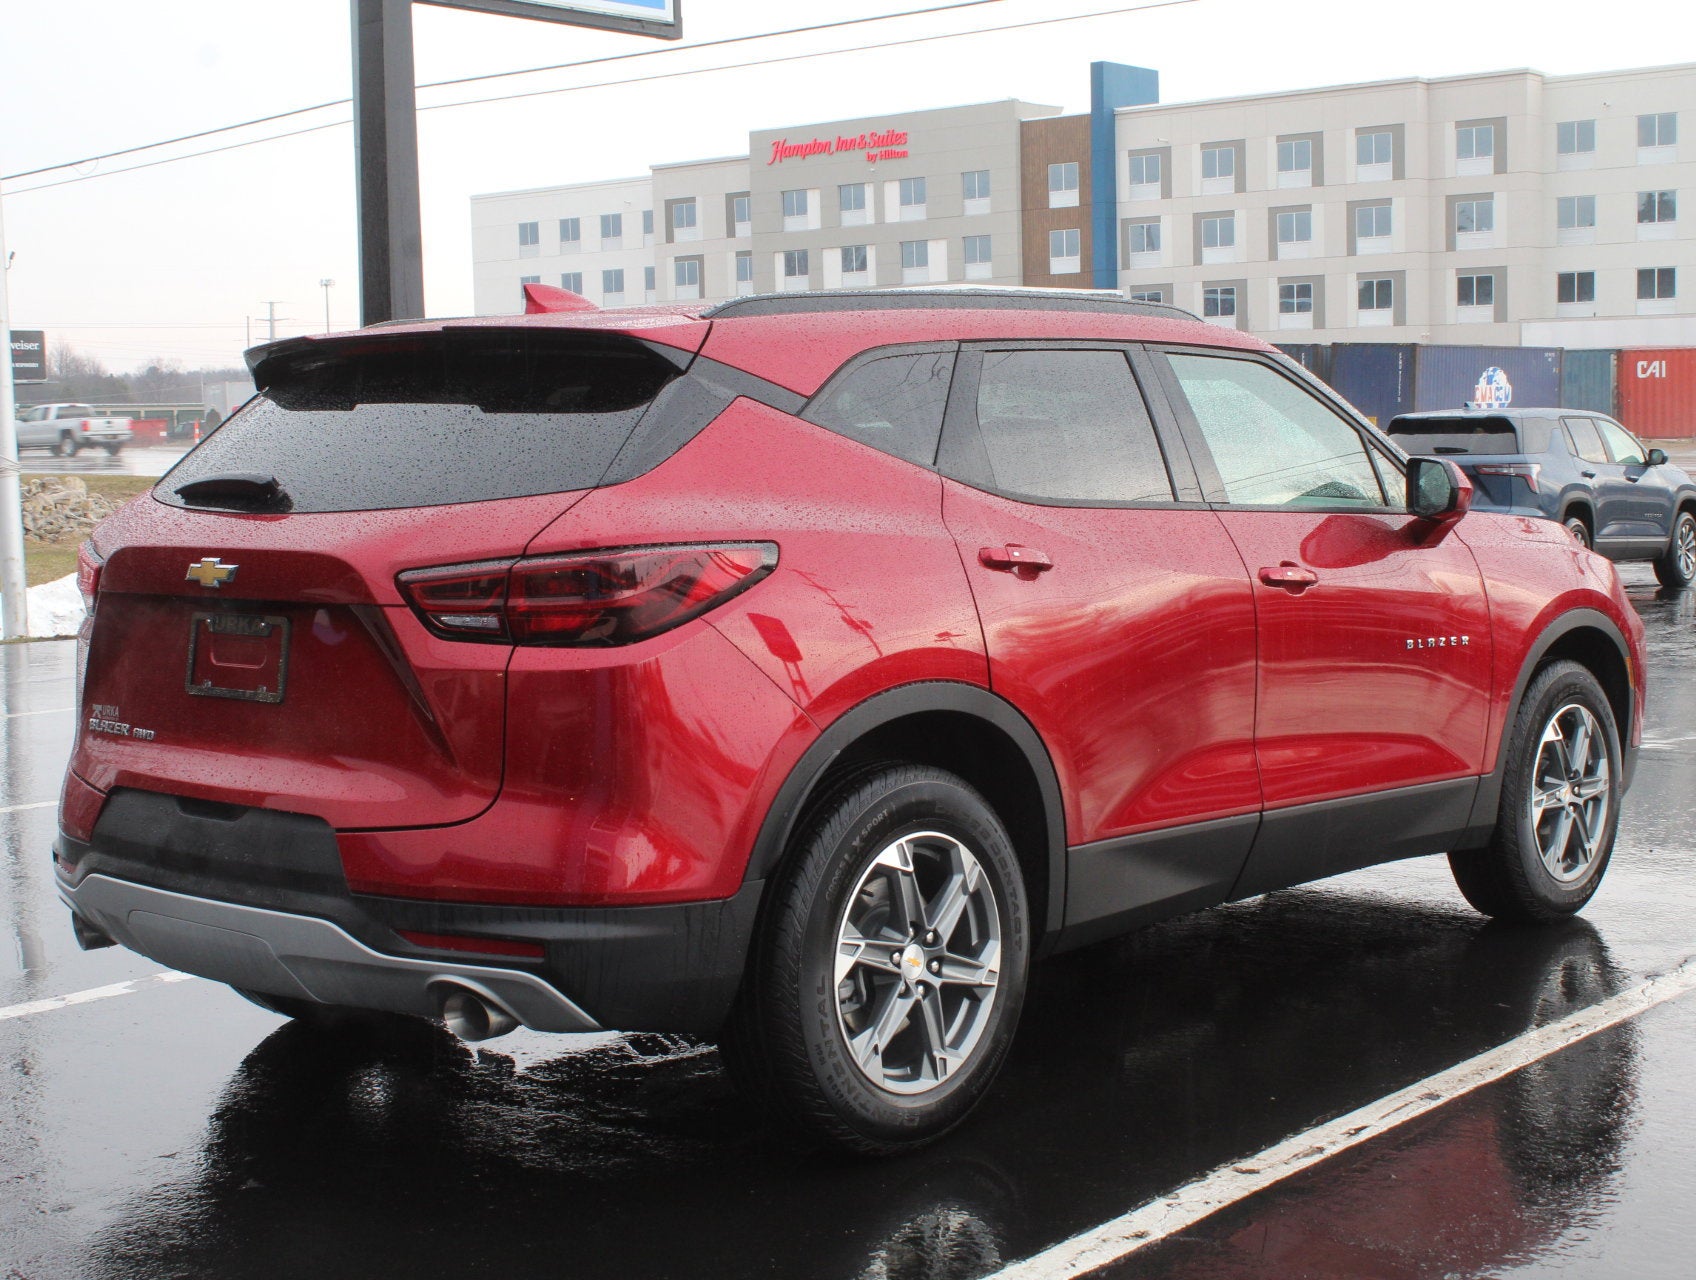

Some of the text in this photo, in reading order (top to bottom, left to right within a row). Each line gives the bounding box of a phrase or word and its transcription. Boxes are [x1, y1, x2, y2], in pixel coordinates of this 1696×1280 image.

[767, 128, 908, 166] Hampton Inn & Suites
[866, 148, 909, 163] by Hilton
[1636, 360, 1666, 379] CAI
[1406, 635, 1470, 650] BLAZER
[89, 717, 155, 741] BLAZER AWD
